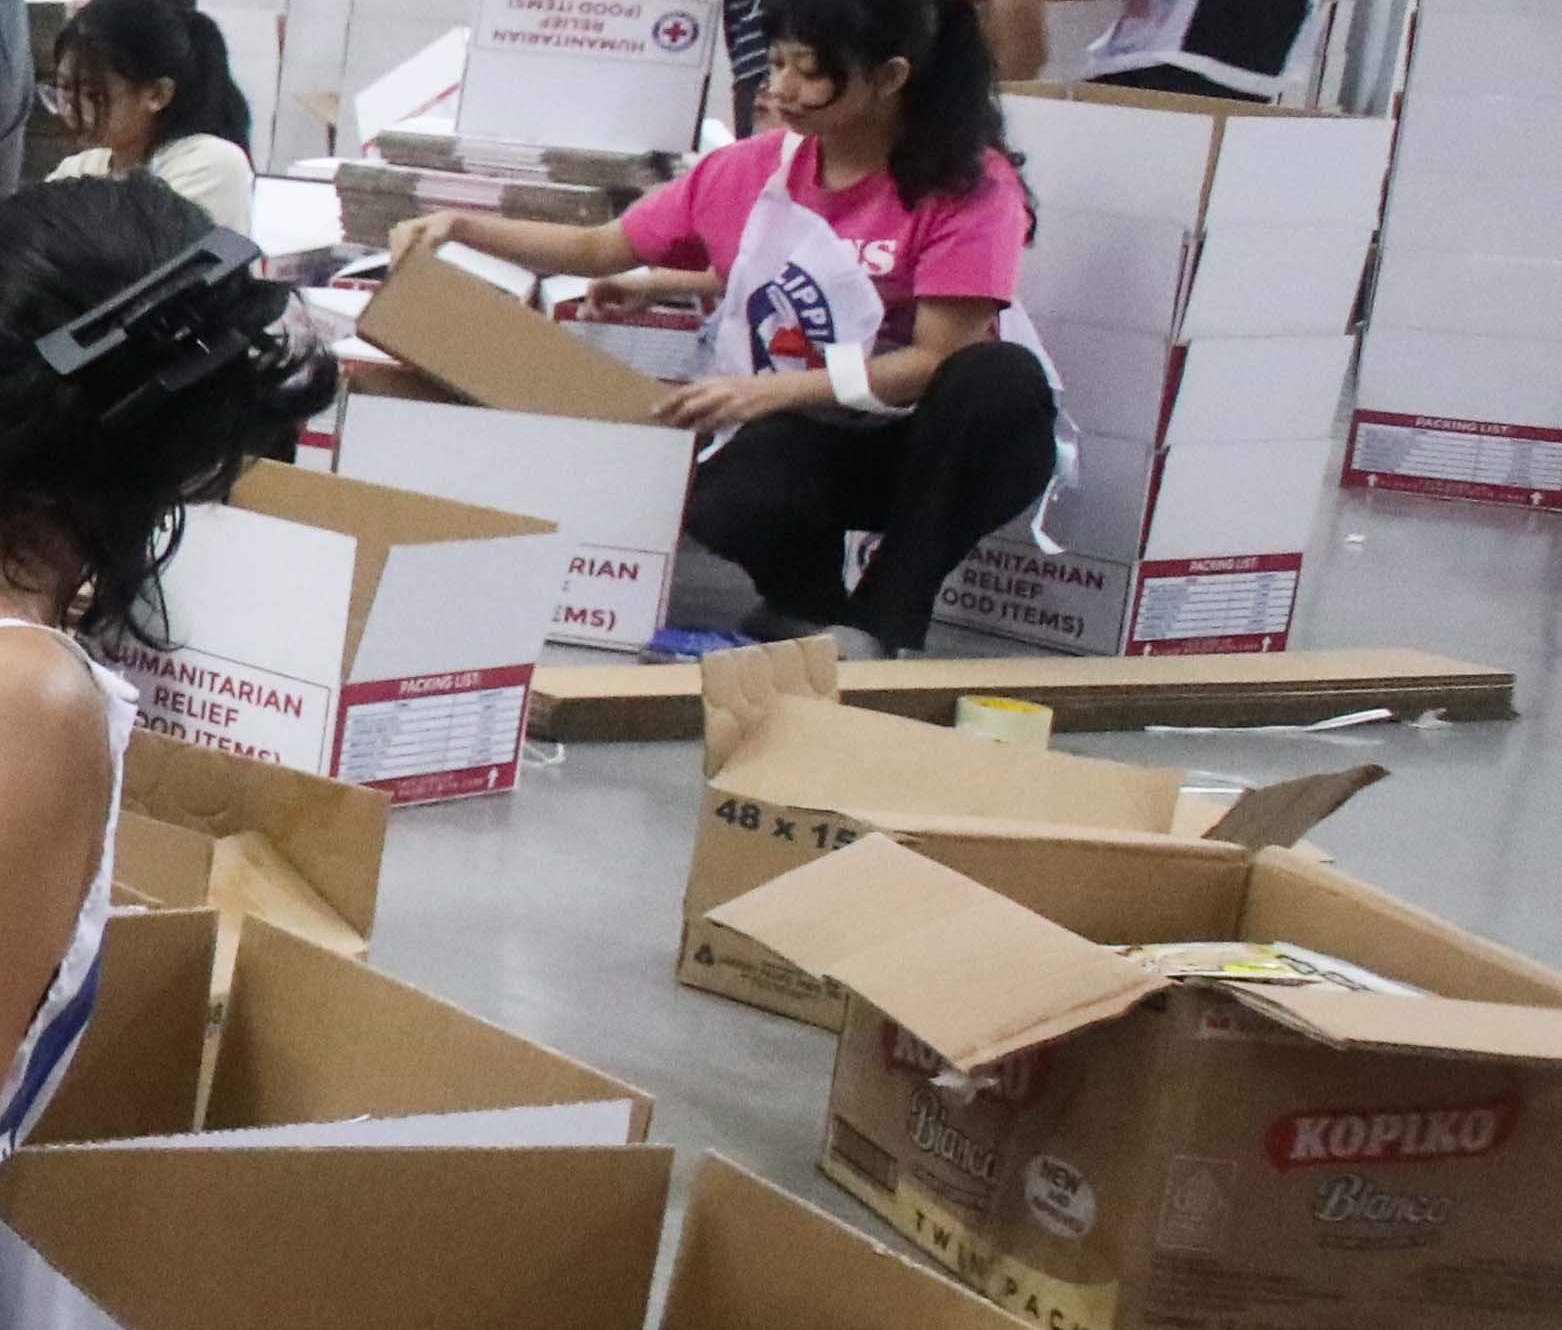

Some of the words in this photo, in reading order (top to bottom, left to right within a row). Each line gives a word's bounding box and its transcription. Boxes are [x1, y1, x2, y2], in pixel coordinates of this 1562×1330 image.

[492, 28, 646, 53] HUMANITARIAN
[1415, 416, 1478, 436] PACKING
[1479, 423, 1511, 435] LIST
[962, 568, 1045, 601] RELIEF
[964, 548, 1105, 591] ANITARIAN
[941, 587, 995, 617] OOD
[1001, 601, 1085, 639] ITEMS)
[399, 675, 452, 695] PACKING
[452, 671, 482, 689] LIST
[154, 685, 241, 729] RELIEF
[715, 797, 761, 831] 48
[773, 819, 796, 842] x
[1289, 1108, 1496, 1161] KOPIKO
[913, 1210, 989, 1276] TWIN
